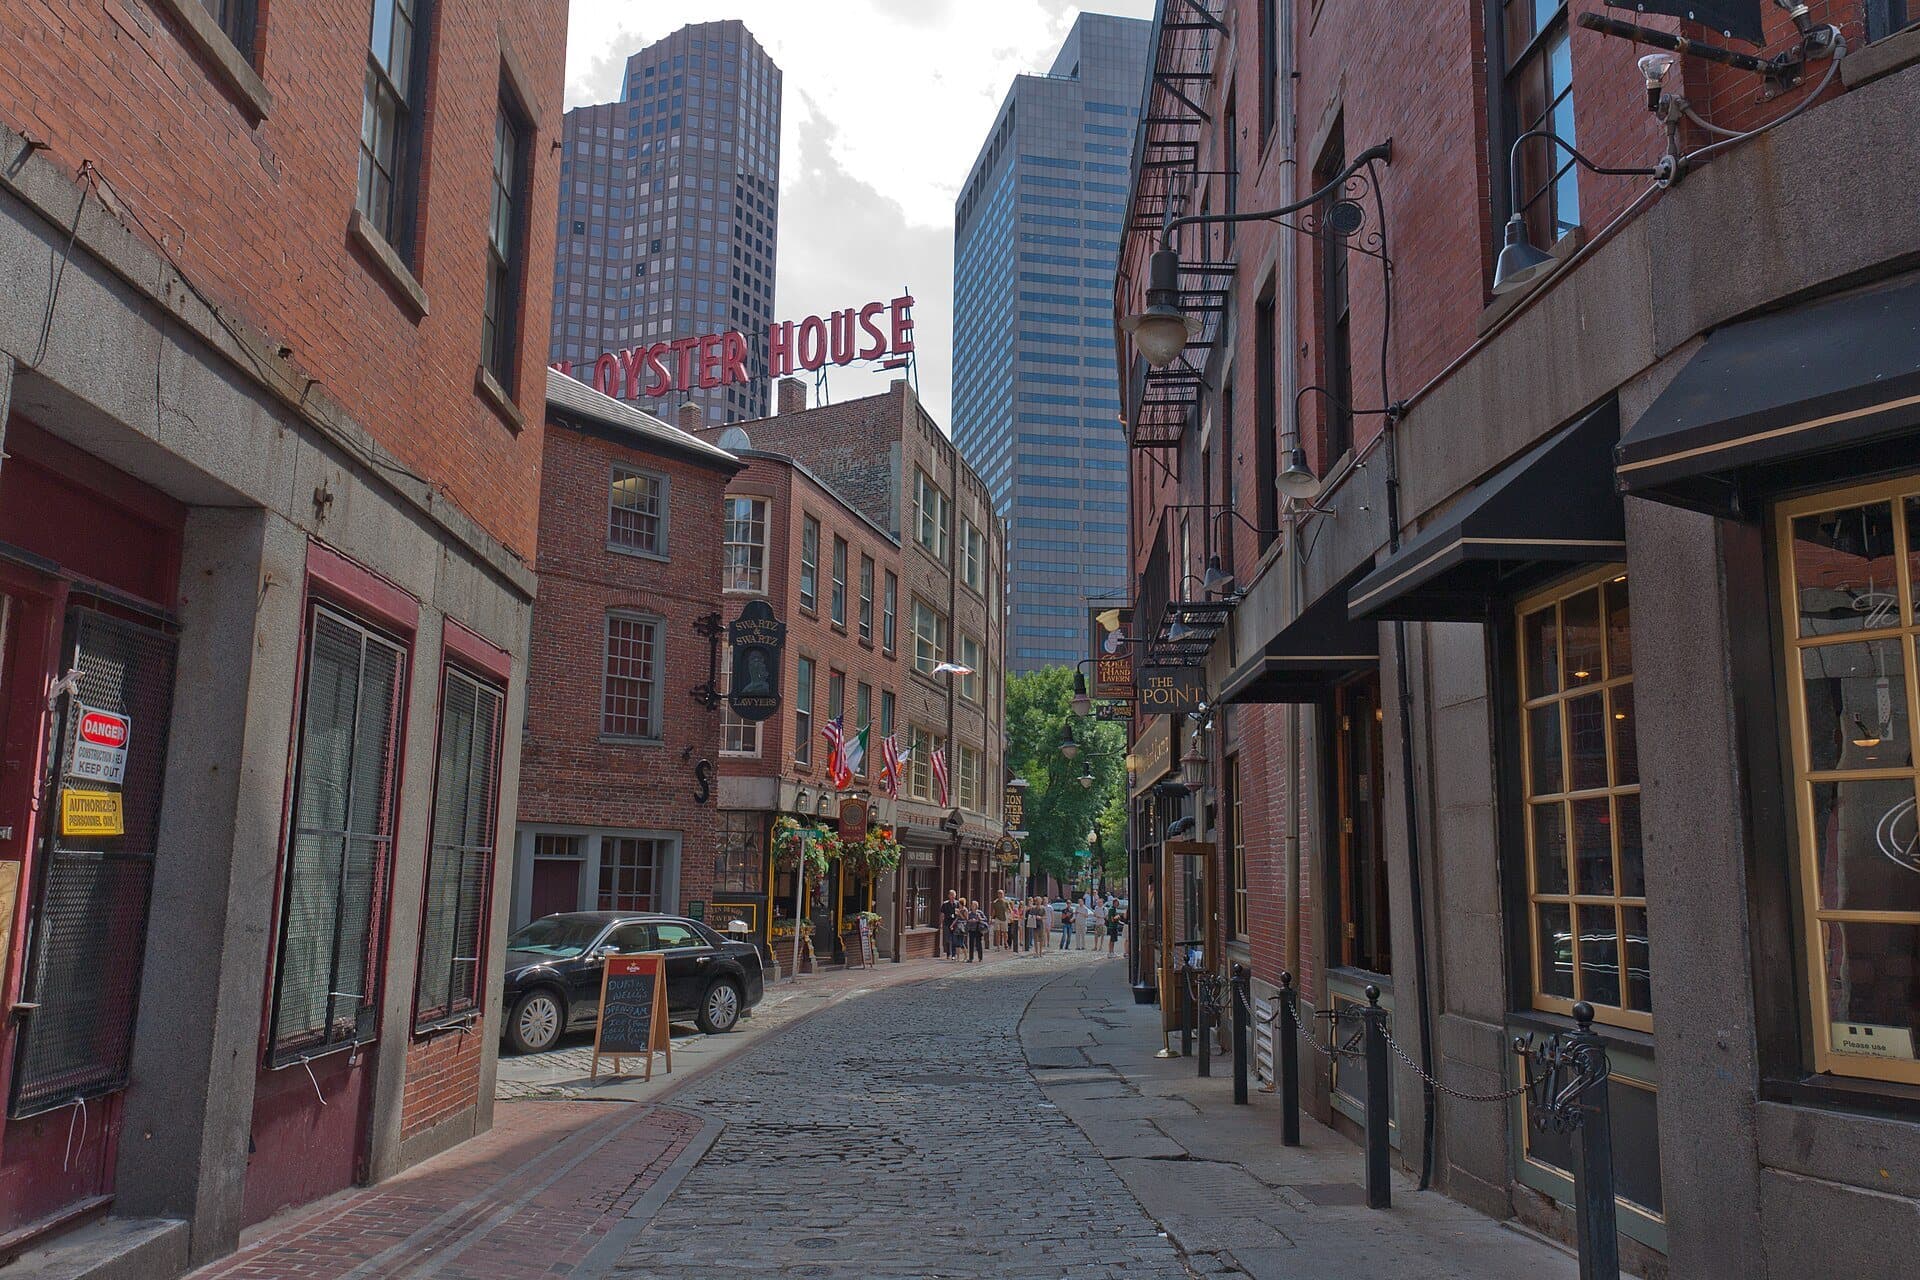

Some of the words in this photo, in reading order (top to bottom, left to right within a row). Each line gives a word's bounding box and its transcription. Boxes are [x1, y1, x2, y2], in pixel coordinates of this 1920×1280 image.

[593, 331, 749, 400] OYSTER
[769, 295, 915, 378] HOUSE
[735, 619, 779, 631] SWARTZ
[754, 627, 761, 635] &
[736, 634, 778, 647] SWARTZ
[1101, 671, 1131, 682] TAVERN
[1148, 676, 1174, 688] THE
[1142, 683, 1203, 707] POINT
[733, 697, 777, 707] LAWYERS
[84, 719, 125, 741] DANGER
[79, 746, 112, 763] CONSTRUCTION
[79, 760, 102, 775] KEEP
[103, 765, 120, 778] OUT
[69, 798, 117, 813] AUTHORIZED
[1006, 795, 1022, 804] ION
[68, 815, 102, 827] PERSONNEL
[1843, 1040, 1869, 1049] Please
